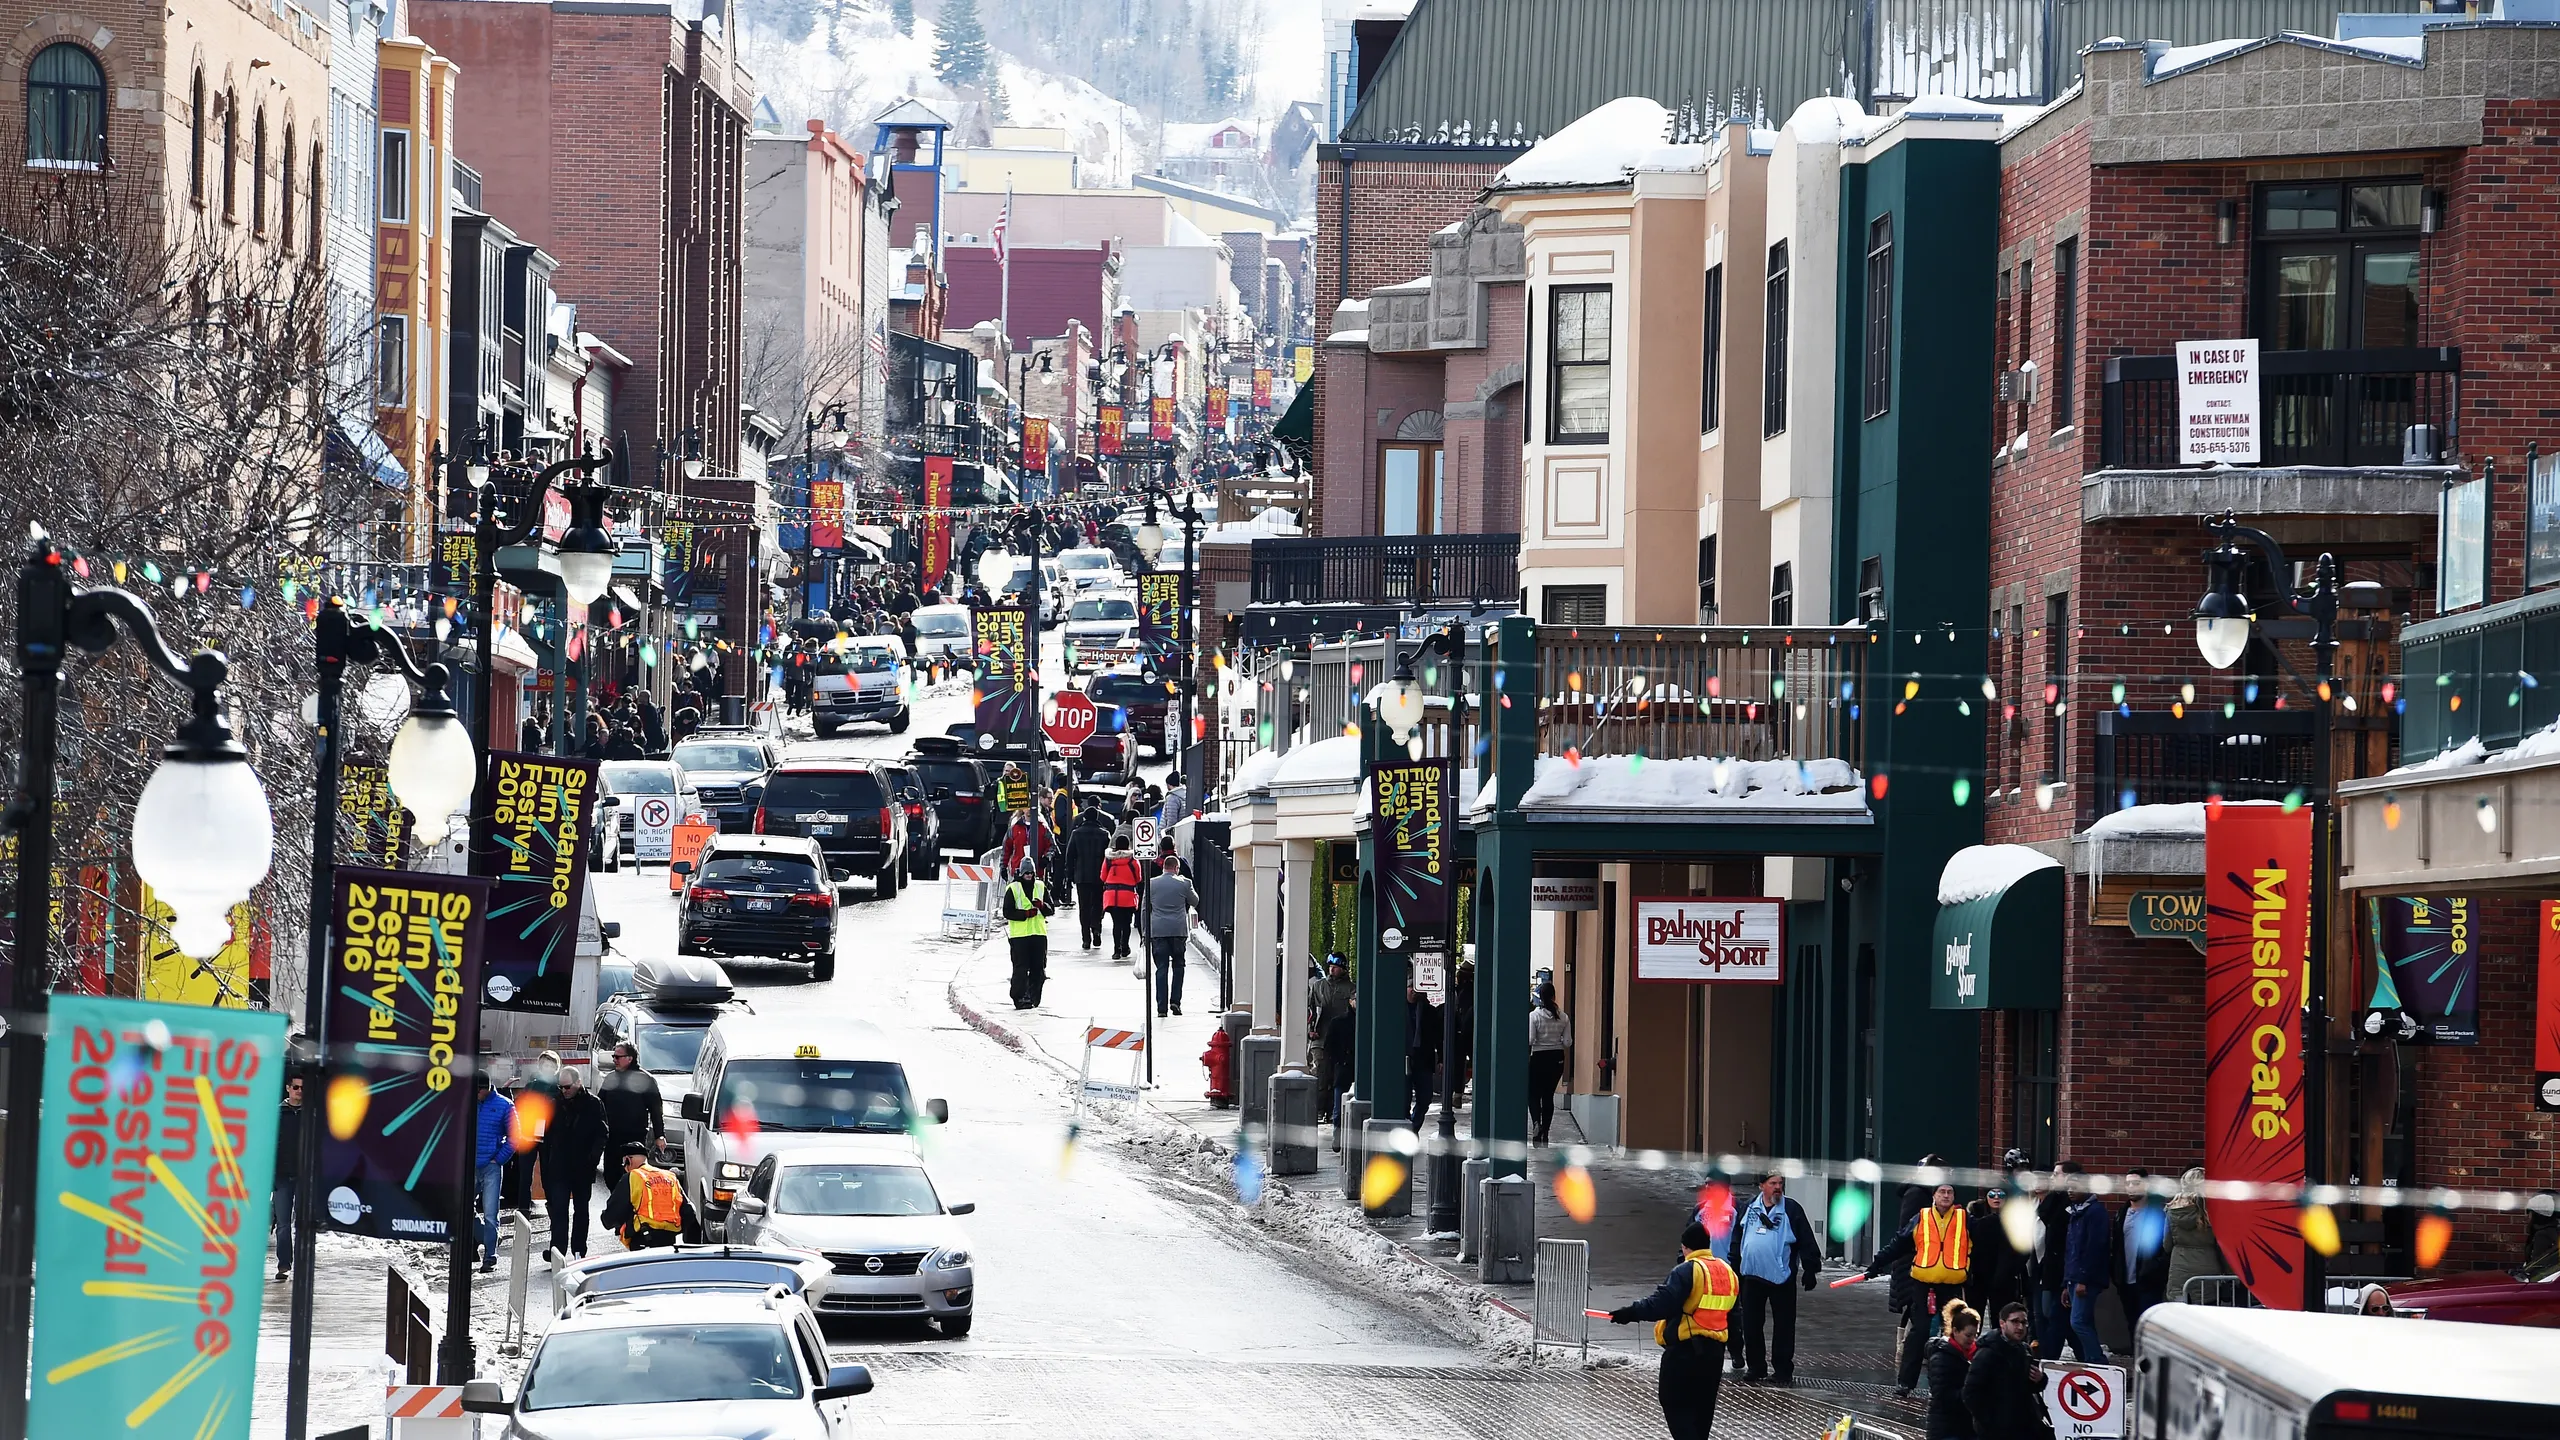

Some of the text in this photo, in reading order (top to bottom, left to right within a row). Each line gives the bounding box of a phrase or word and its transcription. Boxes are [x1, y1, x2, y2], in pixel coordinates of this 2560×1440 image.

[2190, 349, 2245, 364] IN CASE OF
[2188, 370, 2249, 385] EMERGENCY
[2189, 413, 2250, 425] MARK NEWMAN
[2189, 427, 2250, 438] CONSTRUCTION
[2189, 442, 2250, 454] 435-655-5376
[451, 535, 461, 581] Festival
[460, 535, 471, 560] Film
[669, 520, 679, 559] Fstival
[926, 537, 937, 574] Lodge
[1141, 574, 1151, 604] 2016
[1160, 574, 1170, 601] Film
[1170, 574, 1180, 639] Sundance
[988, 611, 1003, 674] Festival
[1001, 611, 1012, 645] Film
[1013, 610, 1026, 693] Sundance
[1091, 650, 1119, 661] Heber
[1060, 747, 1081, 756] 4-WAY
[496, 759, 521, 825] 2016
[538, 765, 565, 823] Film
[1378, 769, 1395, 818] 2016
[1409, 767, 1426, 812] Film
[510, 762, 543, 873] Festival
[1394, 768, 1412, 851] Festival
[1425, 766, 1441, 874] Sundance
[550, 768, 587, 909] Sundance
[686, 834, 700, 843] NO
[1533, 894, 1594, 902] INFORMATION
[1561, 885, 1594, 893] ESTATE
[2142, 895, 2207, 916] TOW
[343, 882, 378, 973] 2016
[405, 889, 439, 971] Film
[368, 886, 409, 1041] Festival
[1416, 957, 1442, 967] PARKING
[425, 892, 472, 1092] Sundance
[487, 983, 521, 994] sundance
[2251, 868, 2291, 1140] Music Café
[799, 1045, 817, 1055] TAXI
[63, 1025, 116, 1169] 2016
[158, 1033, 212, 1163] Film
[193, 1036, 260, 1358] Sundance
[327, 1199, 373, 1214] sundance
[2073, 1423, 2093, 1434] NO
